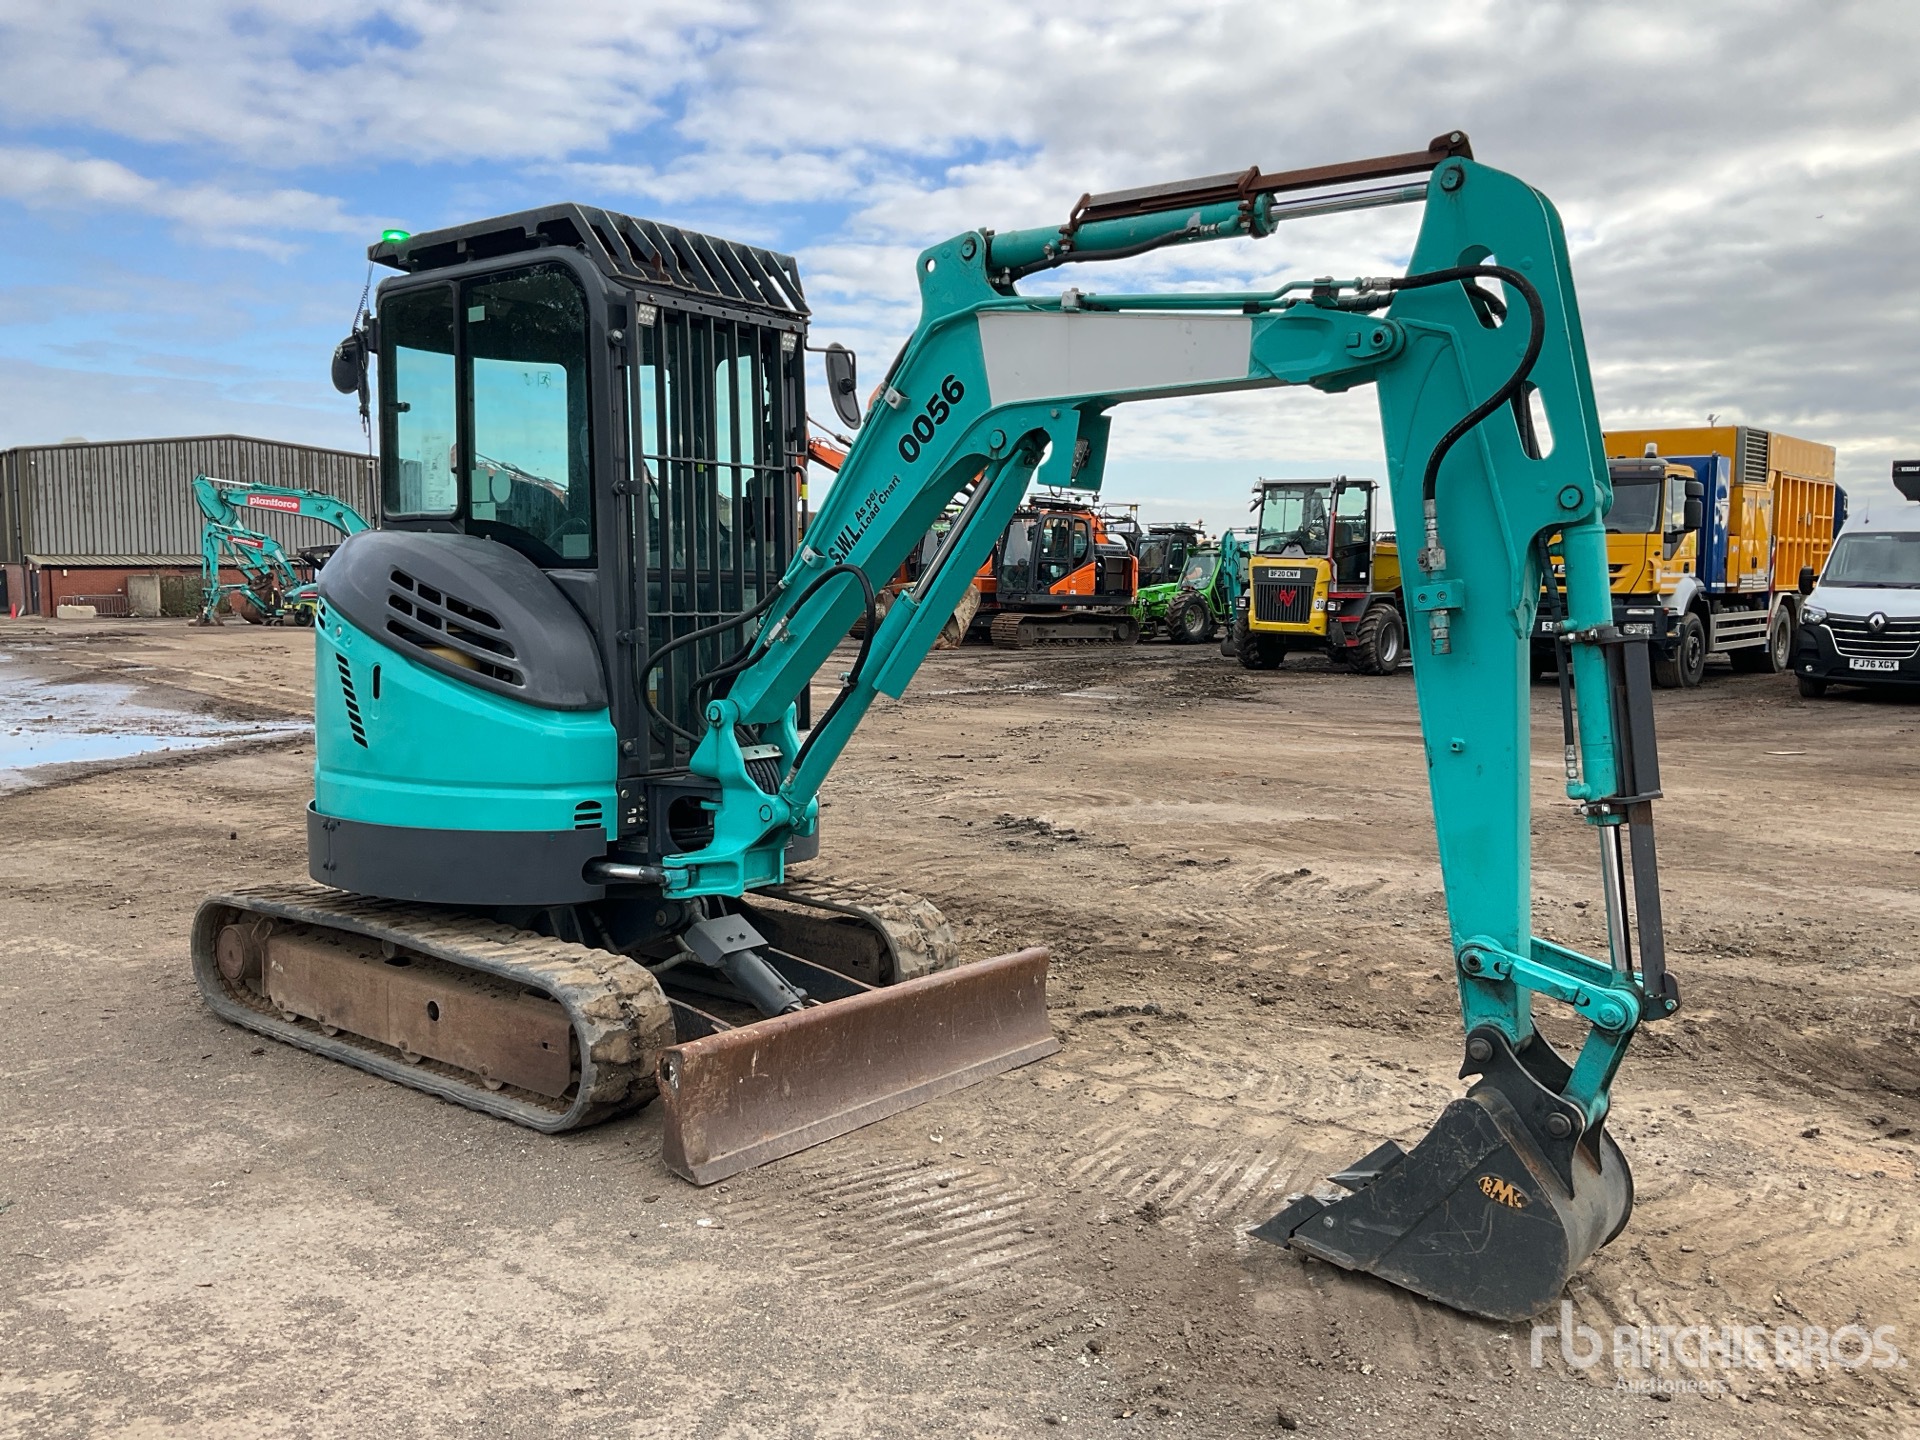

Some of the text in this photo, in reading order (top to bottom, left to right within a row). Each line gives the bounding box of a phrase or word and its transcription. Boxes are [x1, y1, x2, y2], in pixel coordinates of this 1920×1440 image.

[898, 374, 964, 464] 0056
[249, 496, 298, 509] plantforce
[854, 489, 879, 522] As per
[860, 475, 901, 530] Load Chart
[1315, 600, 1326, 610] 30
[1853, 659, 1876, 668] FJ76
